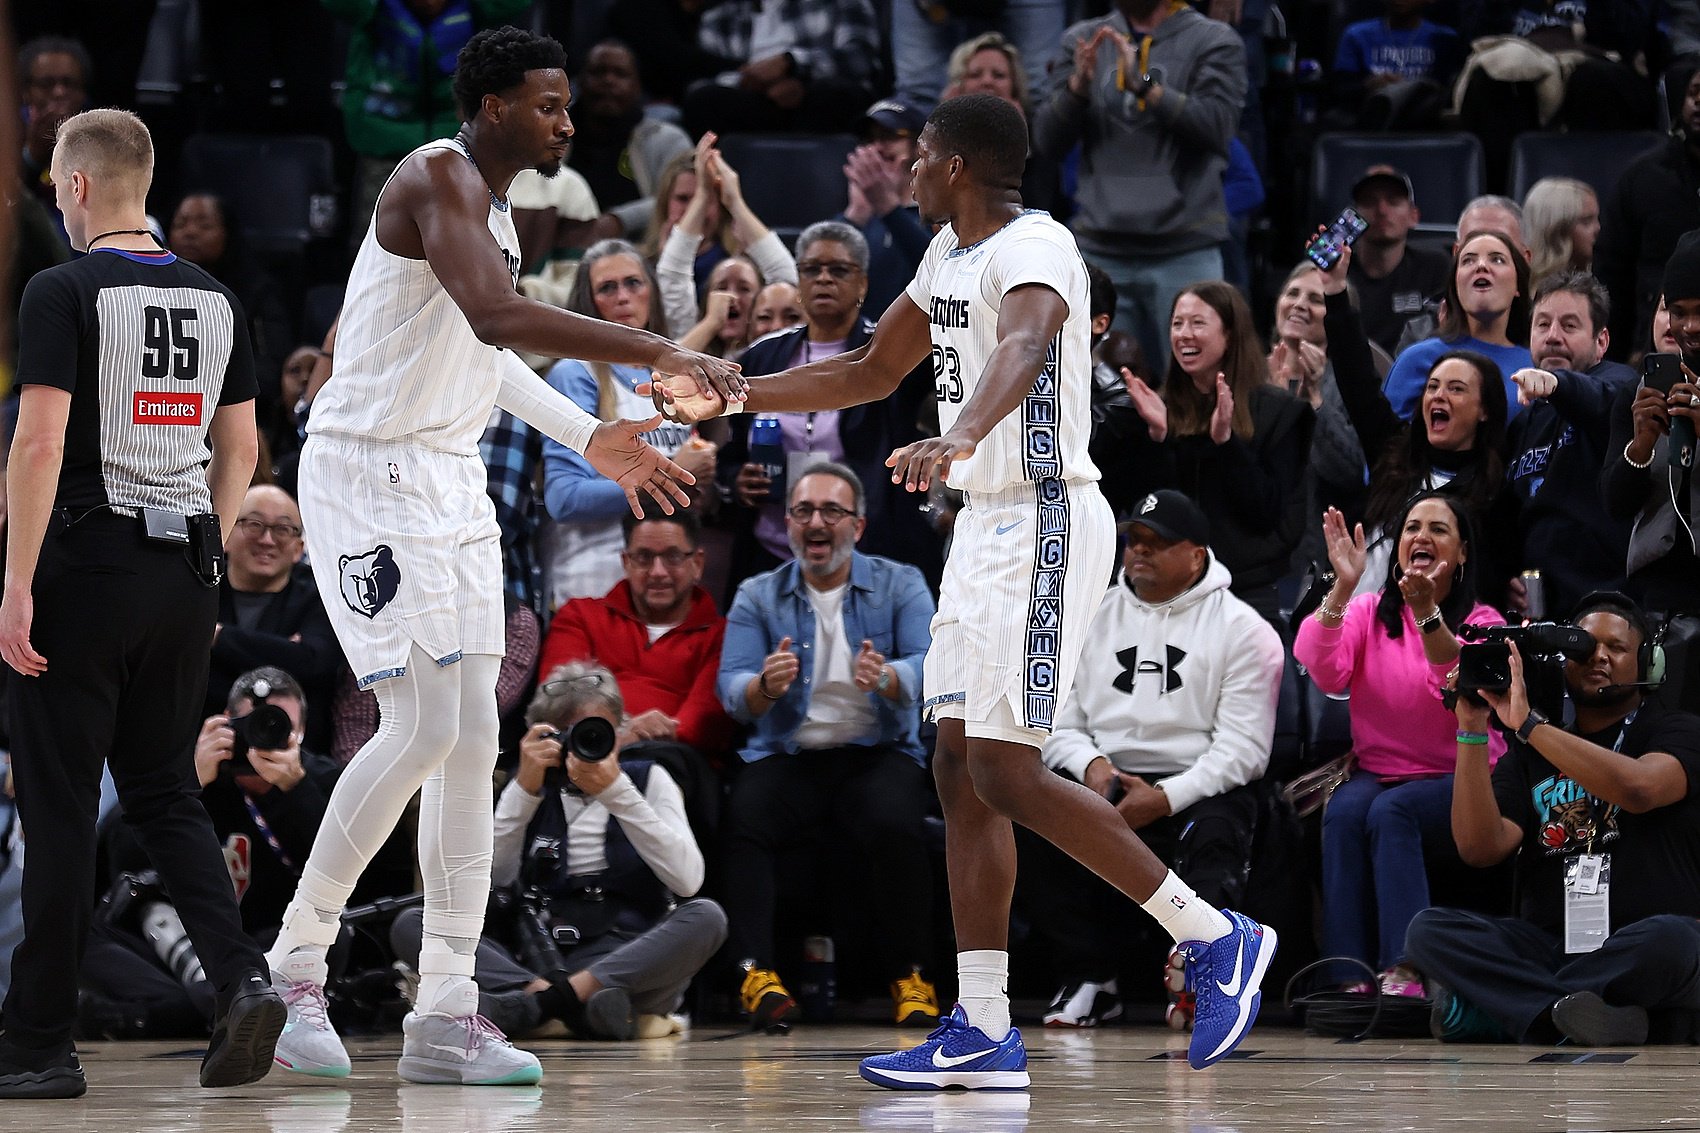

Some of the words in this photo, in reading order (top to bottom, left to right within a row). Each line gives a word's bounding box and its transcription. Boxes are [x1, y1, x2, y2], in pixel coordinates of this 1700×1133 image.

[142, 305, 199, 380] 95
[932, 344, 963, 404] 23
[138, 400, 195, 417] Emirates
